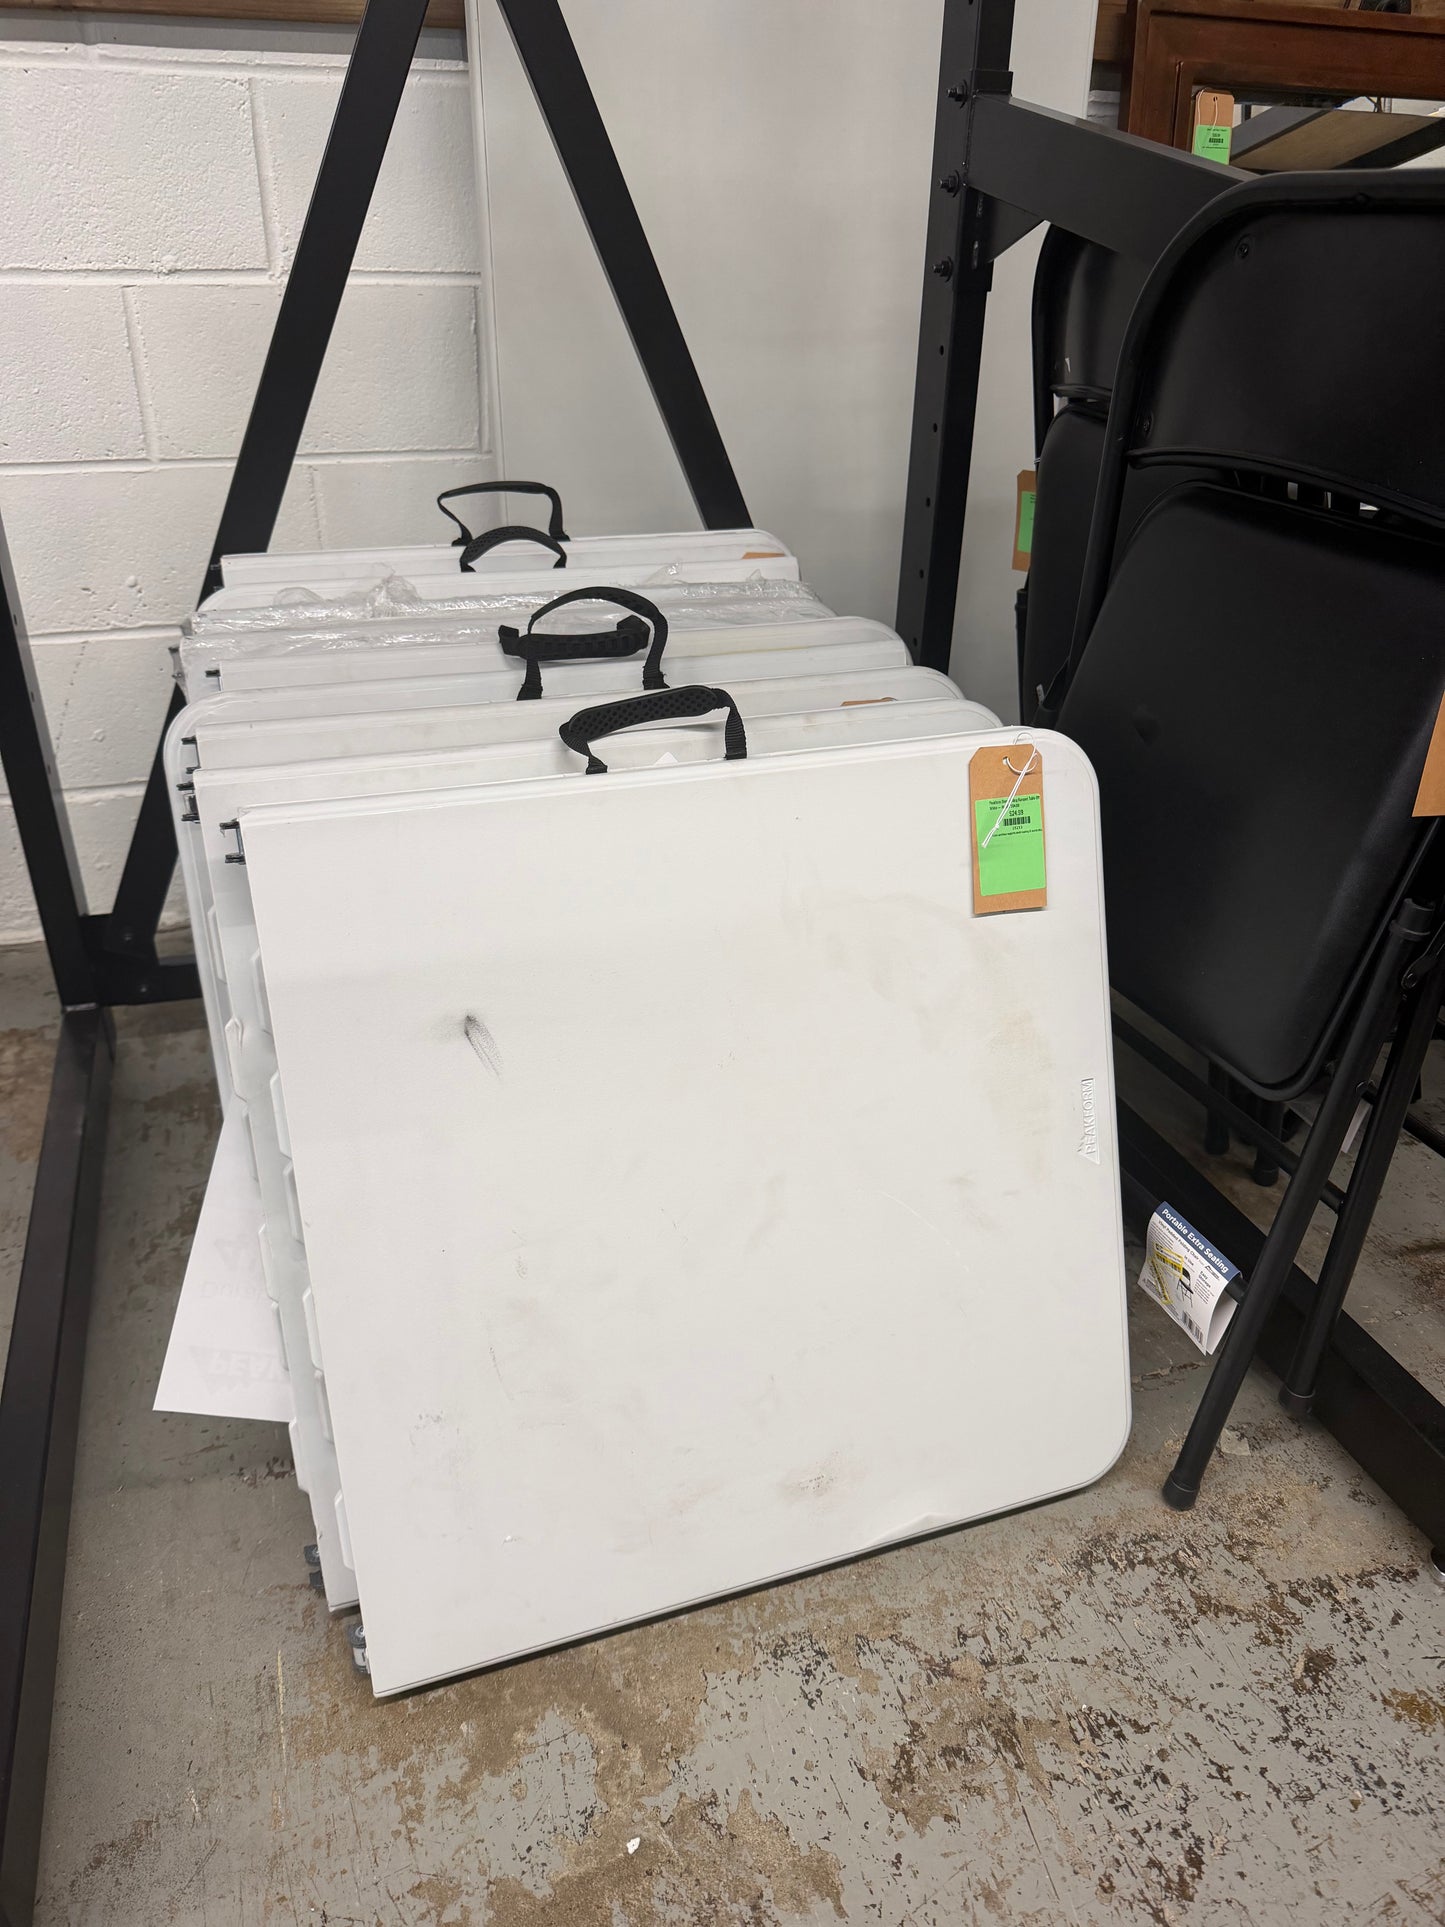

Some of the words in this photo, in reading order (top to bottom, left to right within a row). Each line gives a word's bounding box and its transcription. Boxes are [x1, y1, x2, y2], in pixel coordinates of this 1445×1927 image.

[1081, 1078, 1096, 1154] PEAKFORM
[1162, 1208, 1188, 1234] Portable
[1187, 1232, 1205, 1251] Extra
[1203, 1248, 1229, 1274] Seating
